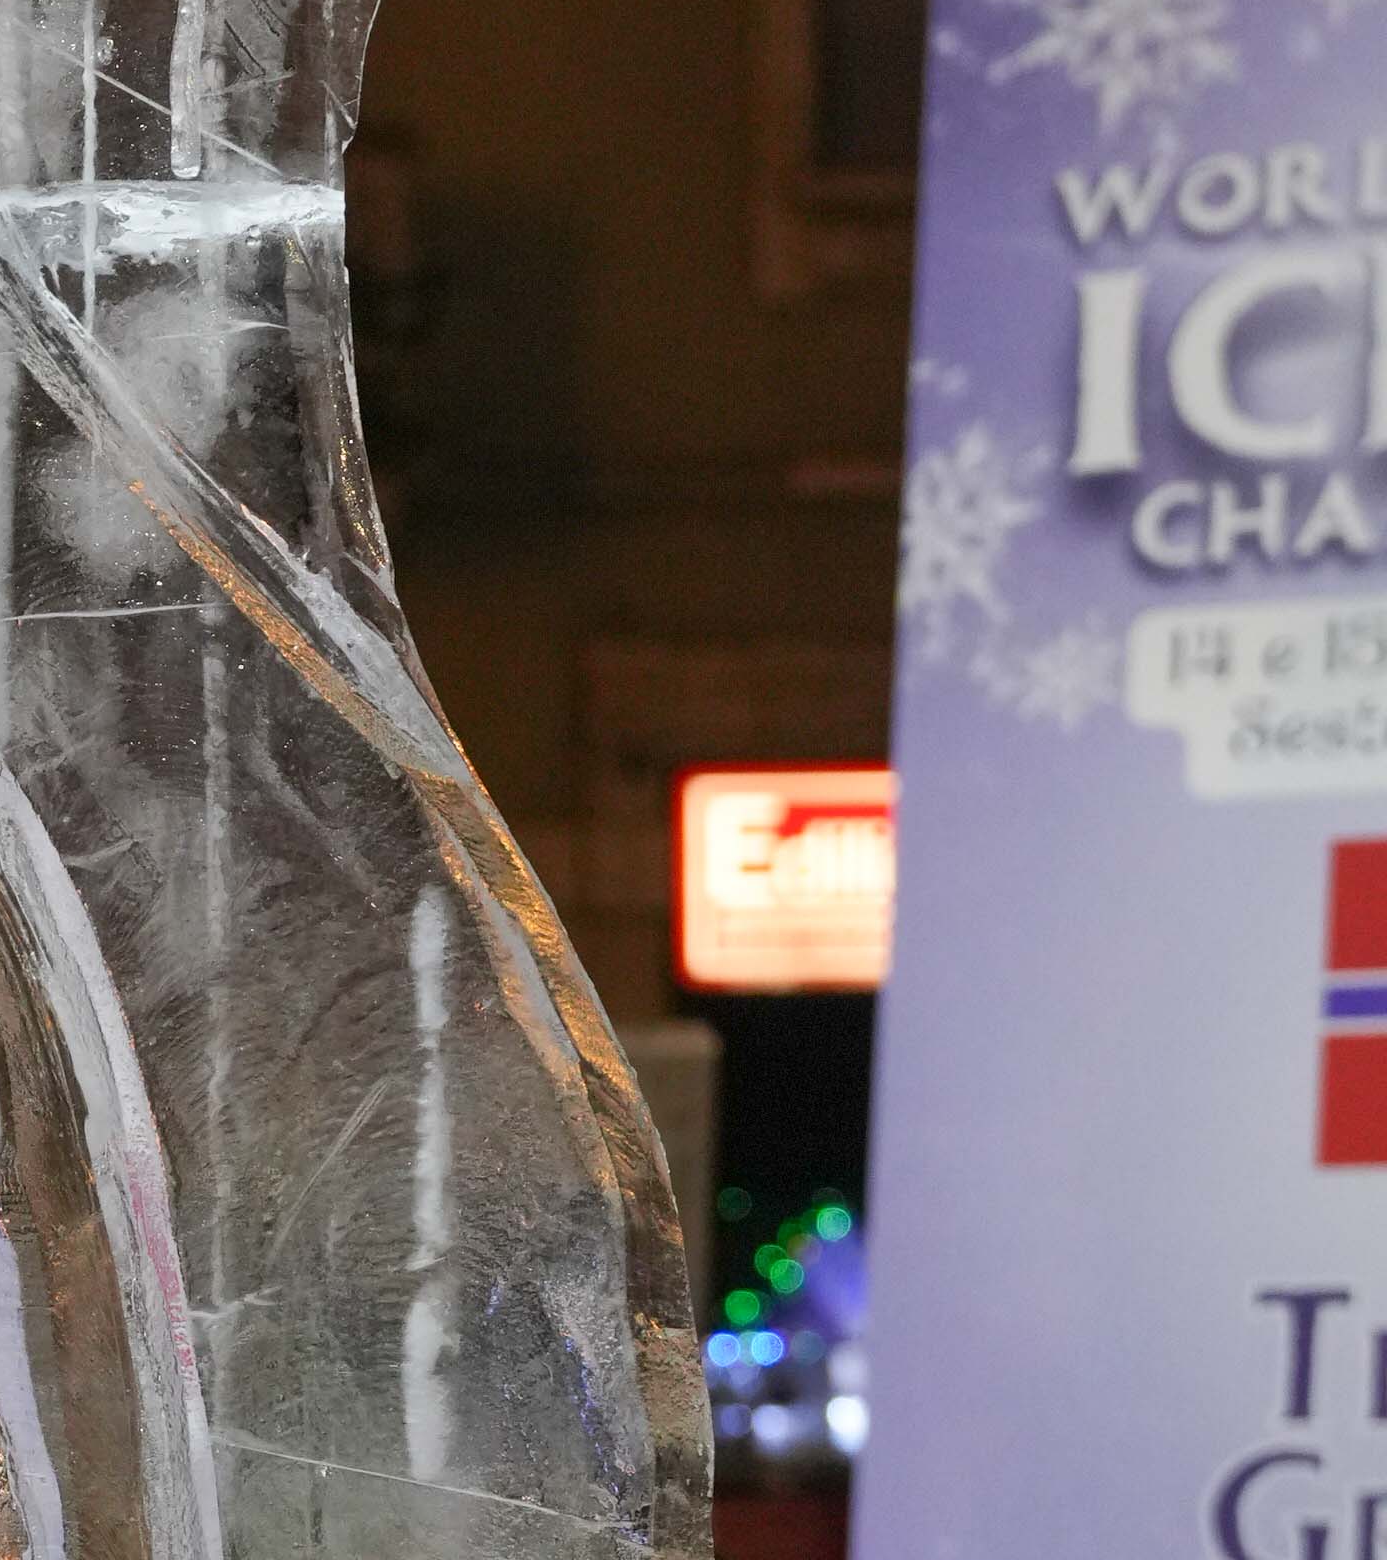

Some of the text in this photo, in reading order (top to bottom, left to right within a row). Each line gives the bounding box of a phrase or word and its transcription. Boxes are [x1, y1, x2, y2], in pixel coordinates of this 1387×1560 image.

[1133, 472, 1374, 568] CHA
[1228, 694, 1387, 762] Sest
[1255, 1286, 1387, 1422] T
